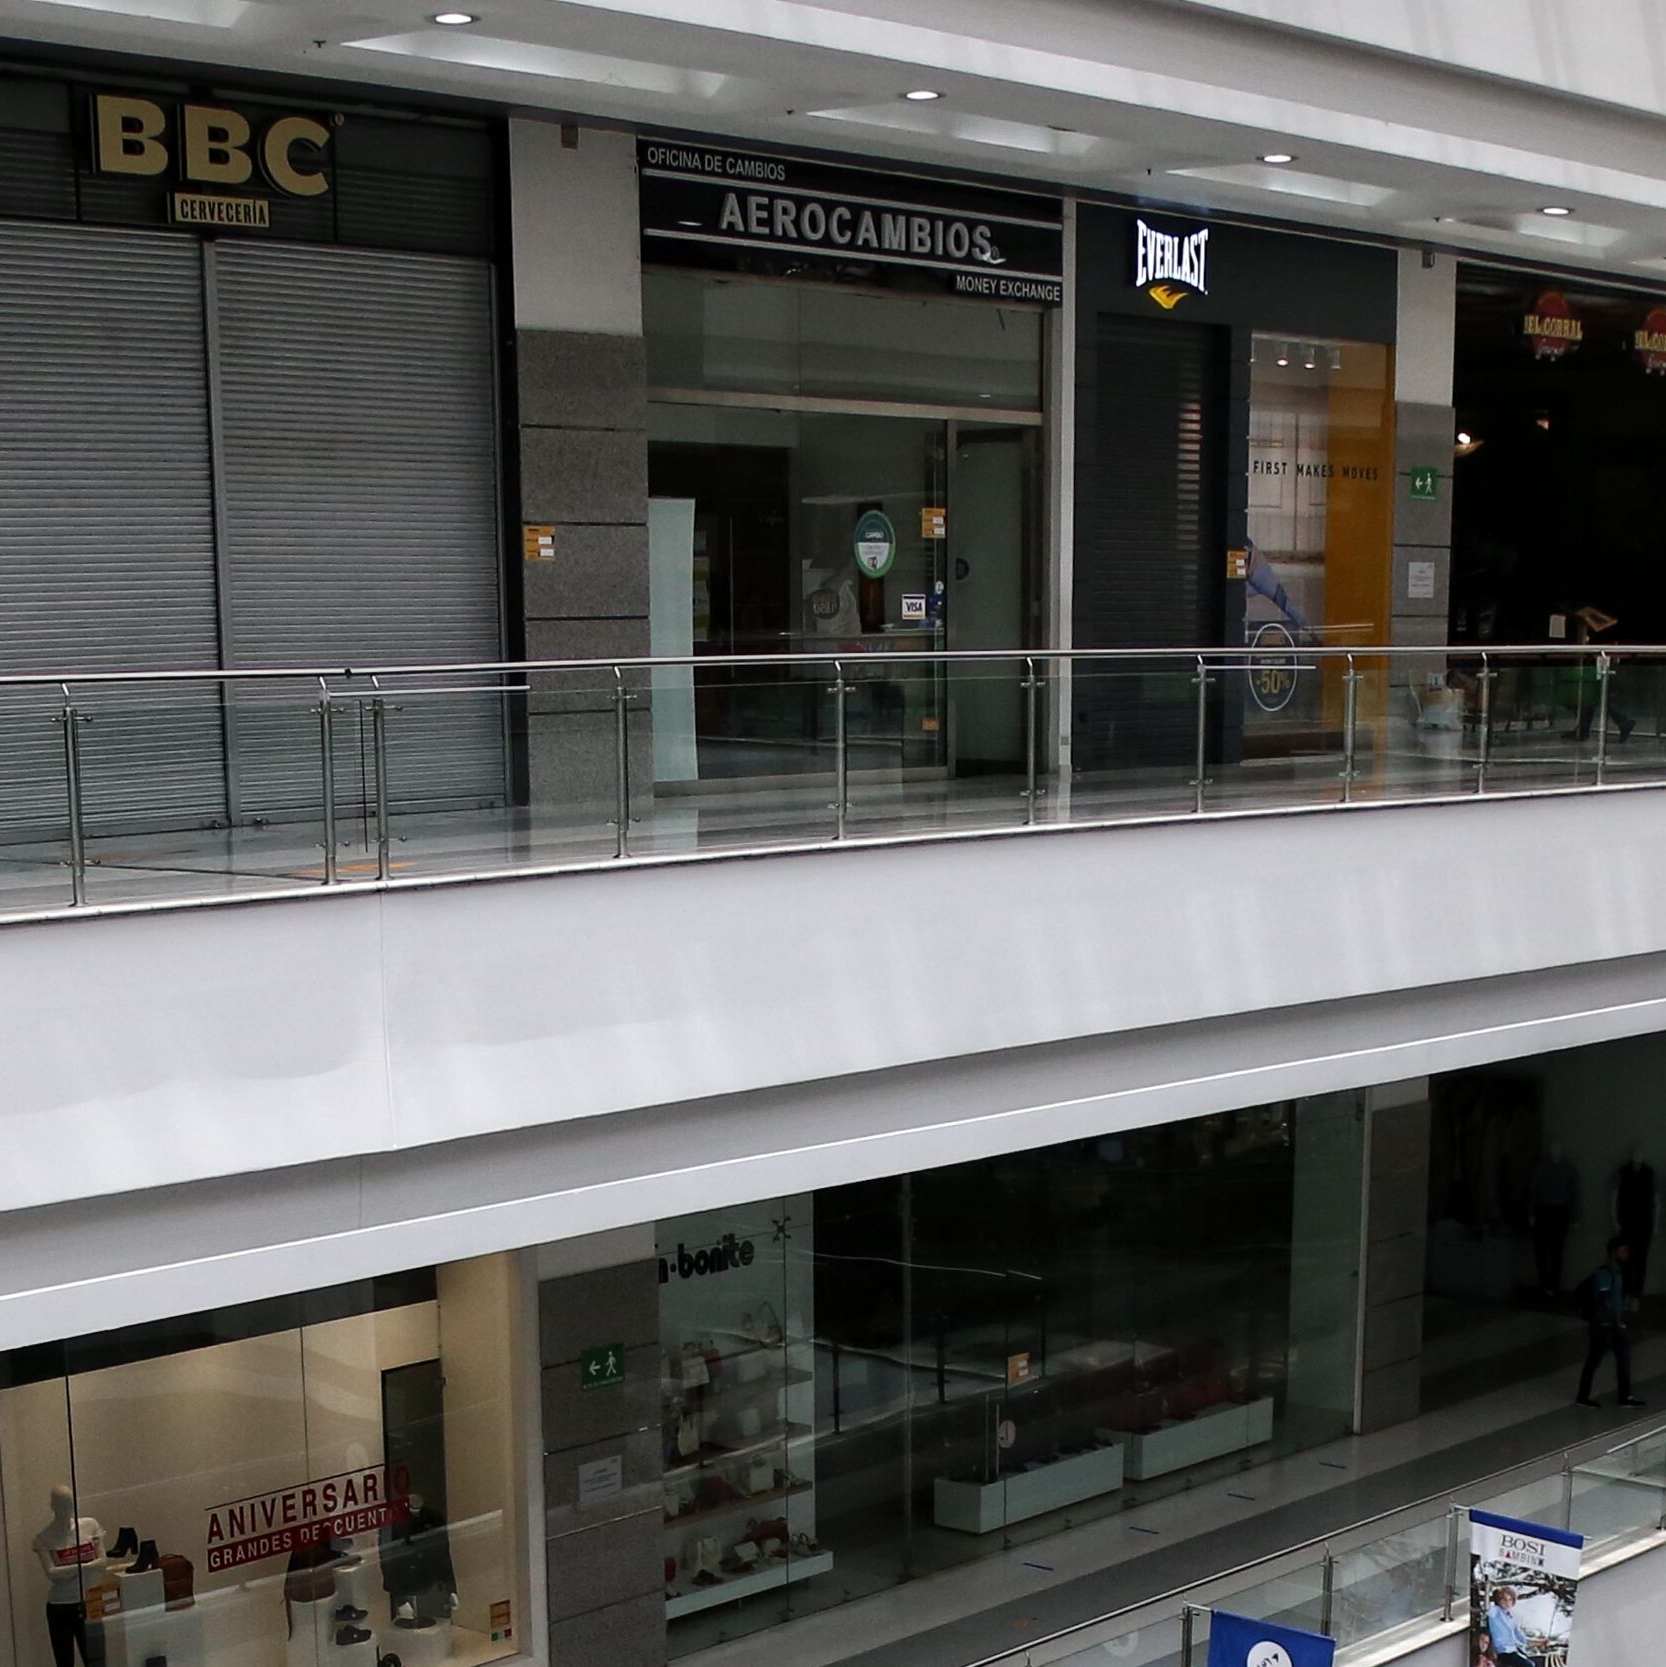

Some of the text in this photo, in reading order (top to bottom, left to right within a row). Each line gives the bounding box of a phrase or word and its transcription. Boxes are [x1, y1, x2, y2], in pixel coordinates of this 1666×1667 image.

[91, 93, 331, 197] BBC
[647, 147, 786, 181] OFICINA DE CAMBIOS
[181, 199, 267, 224] CERVECERÍA
[718, 192, 993, 260] AEROCAMBIOS
[1135, 218, 1209, 292] EVERLAST
[956, 274, 1061, 302] MONEY EXCHANGE
[1253, 460, 1379, 481] FIRST MAKES MOVES
[905, 602, 923, 613] VISA
[210, 1532, 293, 1569] GRANDES
[1500, 1533, 1546, 1557] BOSI
